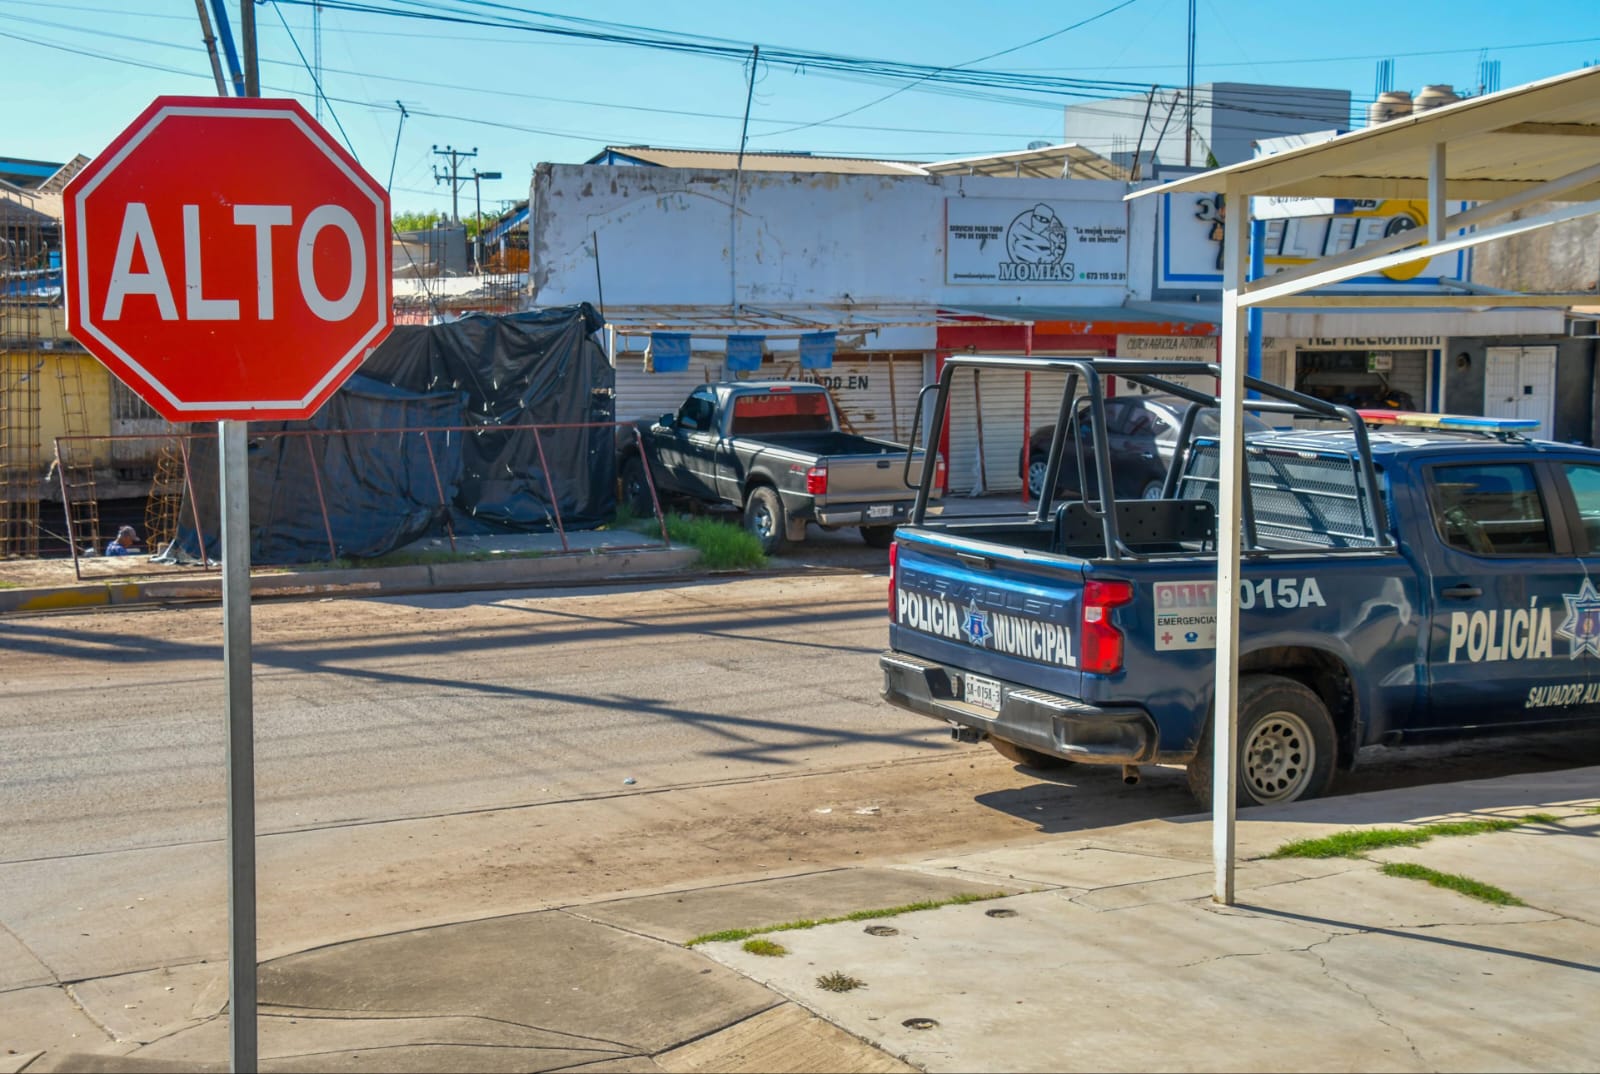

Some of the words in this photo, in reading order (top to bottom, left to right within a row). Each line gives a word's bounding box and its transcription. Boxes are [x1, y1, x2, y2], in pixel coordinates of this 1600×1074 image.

[102, 202, 367, 322] ALTO
[999, 262, 1074, 281] MOMIAS
[848, 375, 869, 390] EN
[1160, 586, 1212, 608] 911
[1239, 577, 1327, 610] 015A
[898, 588, 961, 640] POLICÍA
[991, 612, 1077, 668] MUNICIPAL
[1448, 595, 1553, 664] POLICÍA
[1525, 683, 1585, 709] SALVADOR
